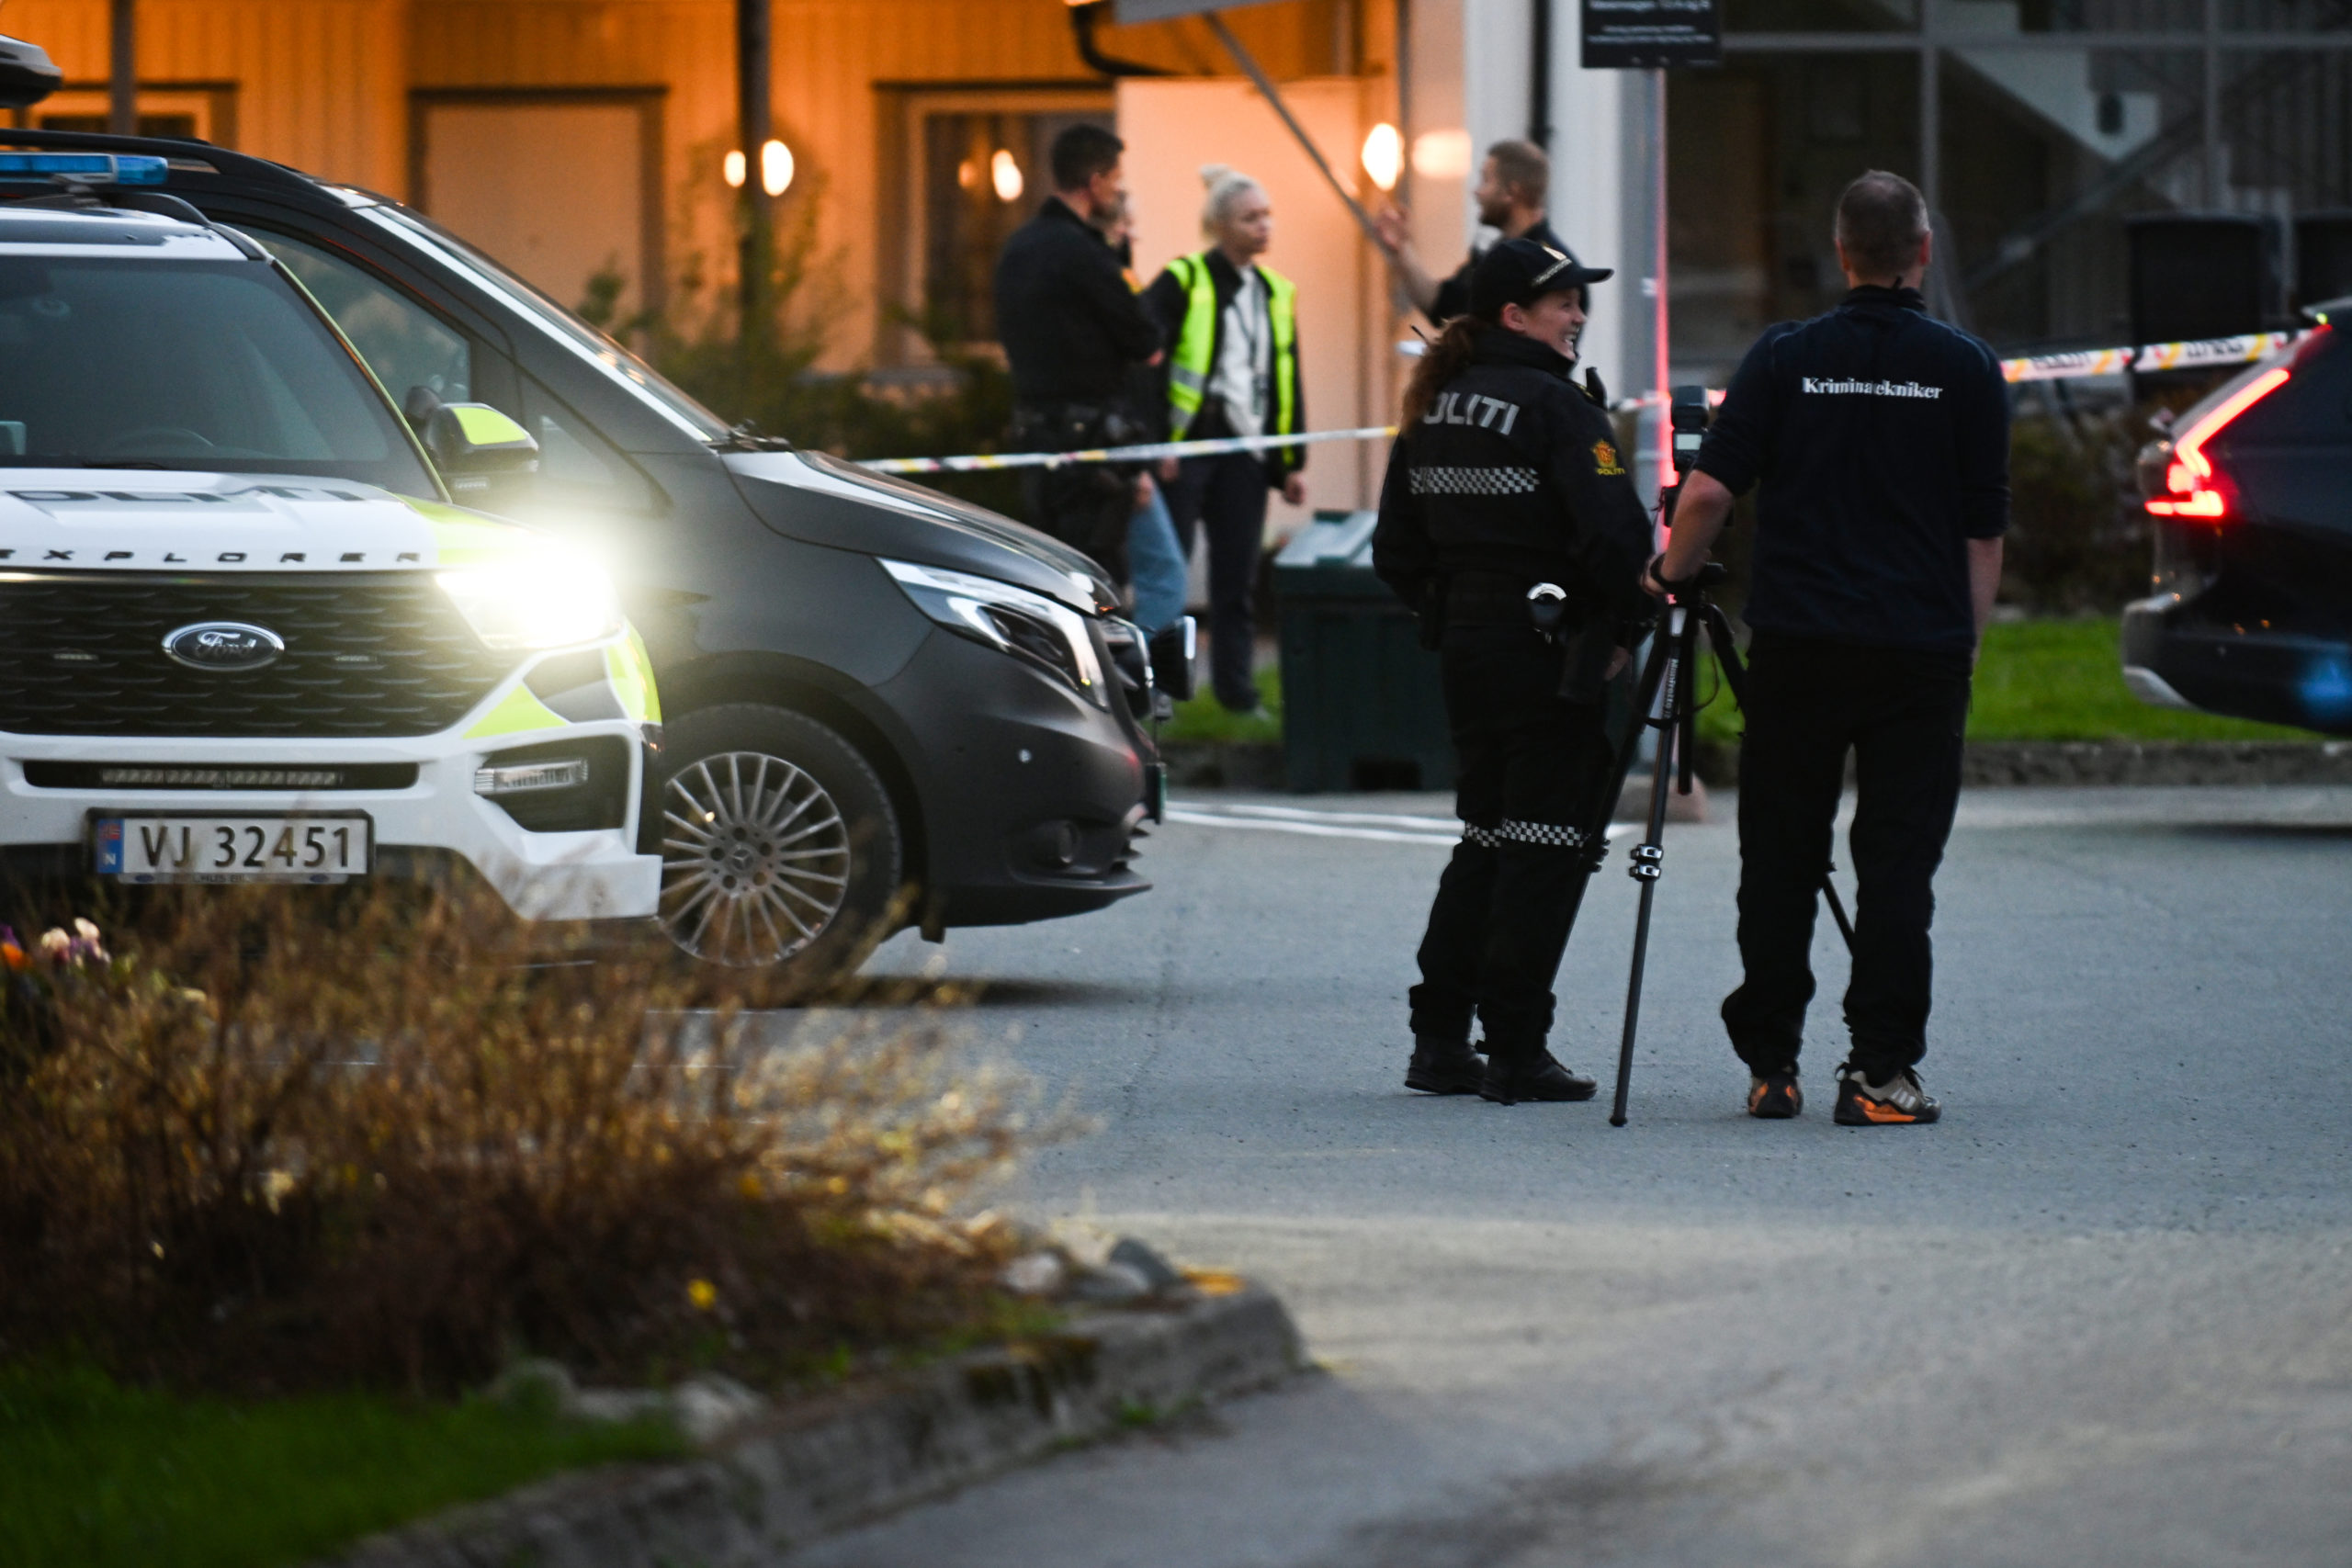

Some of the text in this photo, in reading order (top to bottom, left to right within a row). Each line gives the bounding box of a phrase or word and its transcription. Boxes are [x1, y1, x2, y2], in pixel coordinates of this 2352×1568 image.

[1422, 391, 1521, 435] OLITI
[5, 485, 367, 502] OLITI
[195, 630, 257, 658] Ford
[141, 826, 350, 867] VJ 32451
